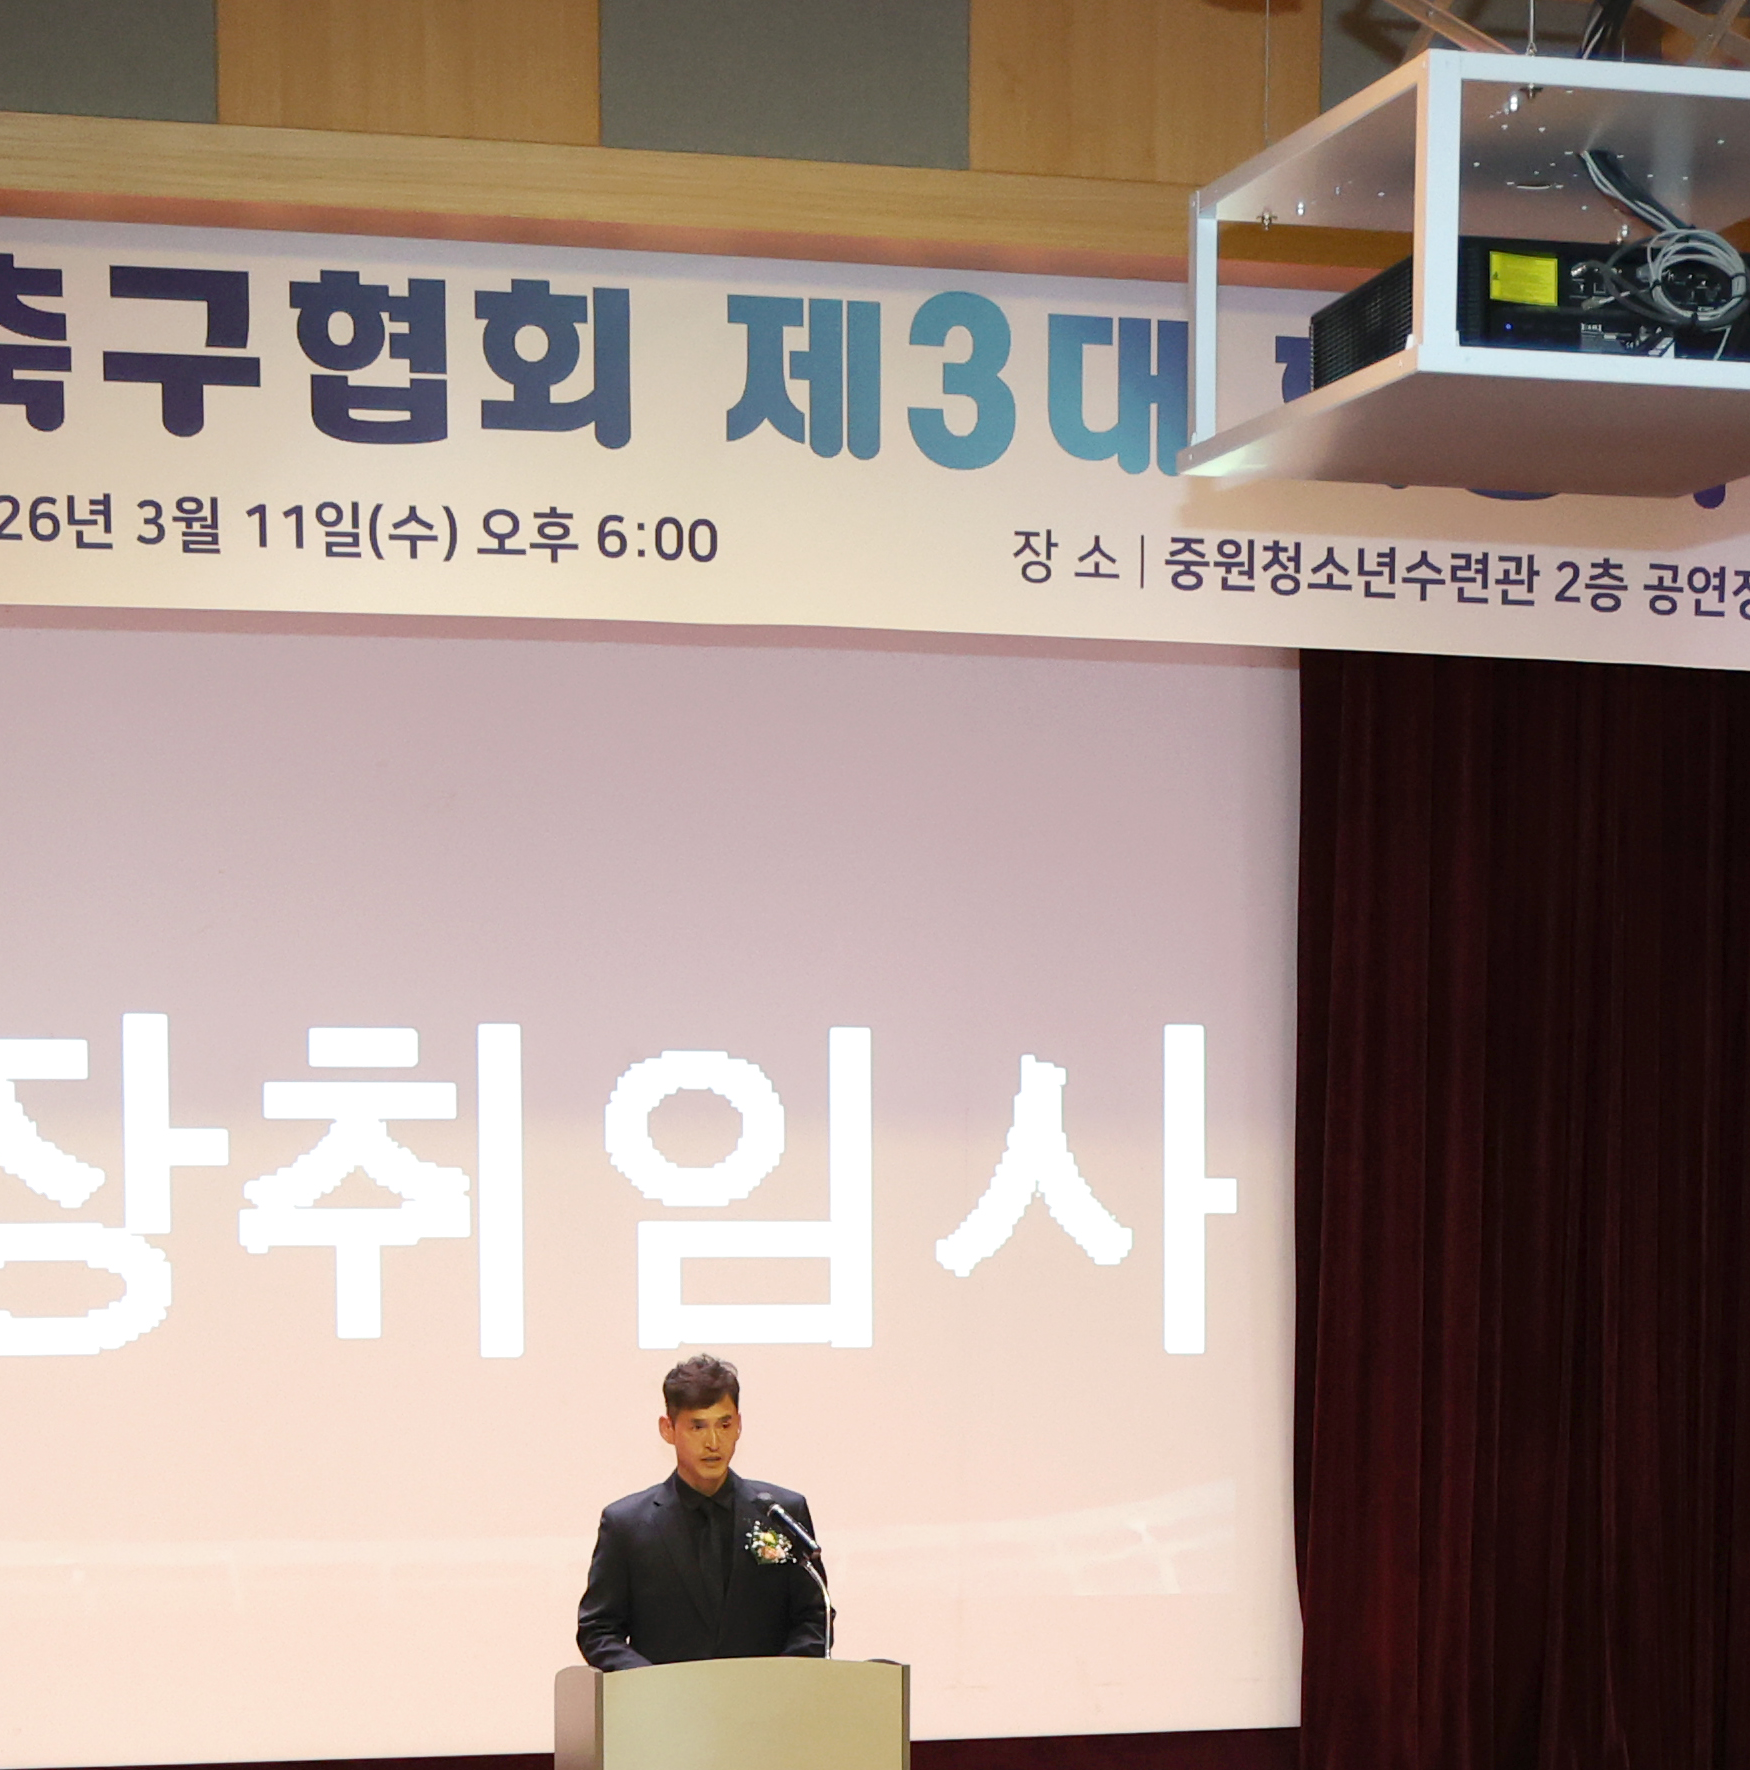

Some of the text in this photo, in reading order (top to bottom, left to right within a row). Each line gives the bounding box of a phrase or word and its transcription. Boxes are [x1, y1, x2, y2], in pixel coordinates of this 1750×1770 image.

[726, 290, 1190, 477] 제3대
[135, 495, 222, 555] 3월
[244, 500, 459, 562] 11일(수)
[476, 506, 580, 564] 오후
[596, 513, 719, 564] 6:00
[1164, 536, 1541, 607] 중원청소년수련관
[1554, 557, 1629, 613] 2층
